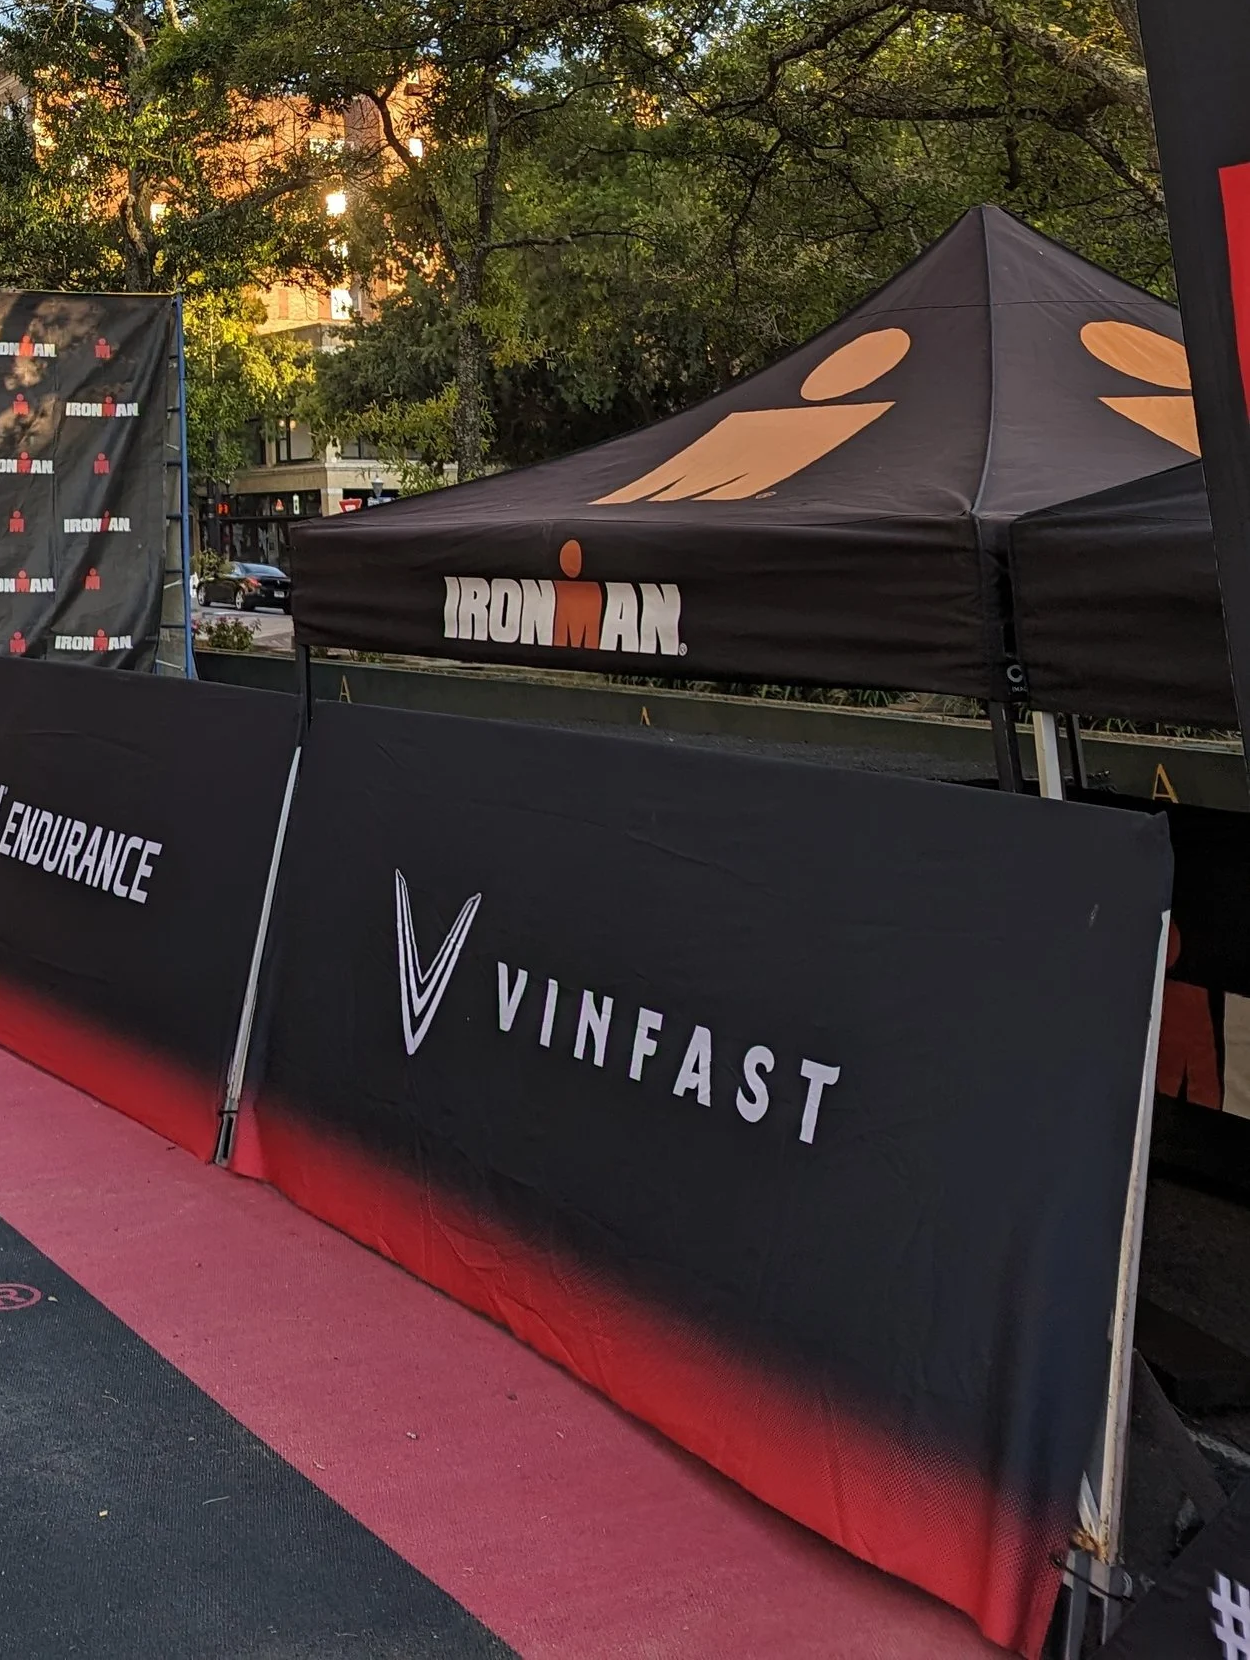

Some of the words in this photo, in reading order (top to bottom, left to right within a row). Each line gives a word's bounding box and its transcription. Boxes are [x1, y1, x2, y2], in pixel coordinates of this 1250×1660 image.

[66, 396, 139, 417] IRONMAN
[54, 628, 133, 651] IRONMAN
[497, 961, 841, 1144] VINFAST
